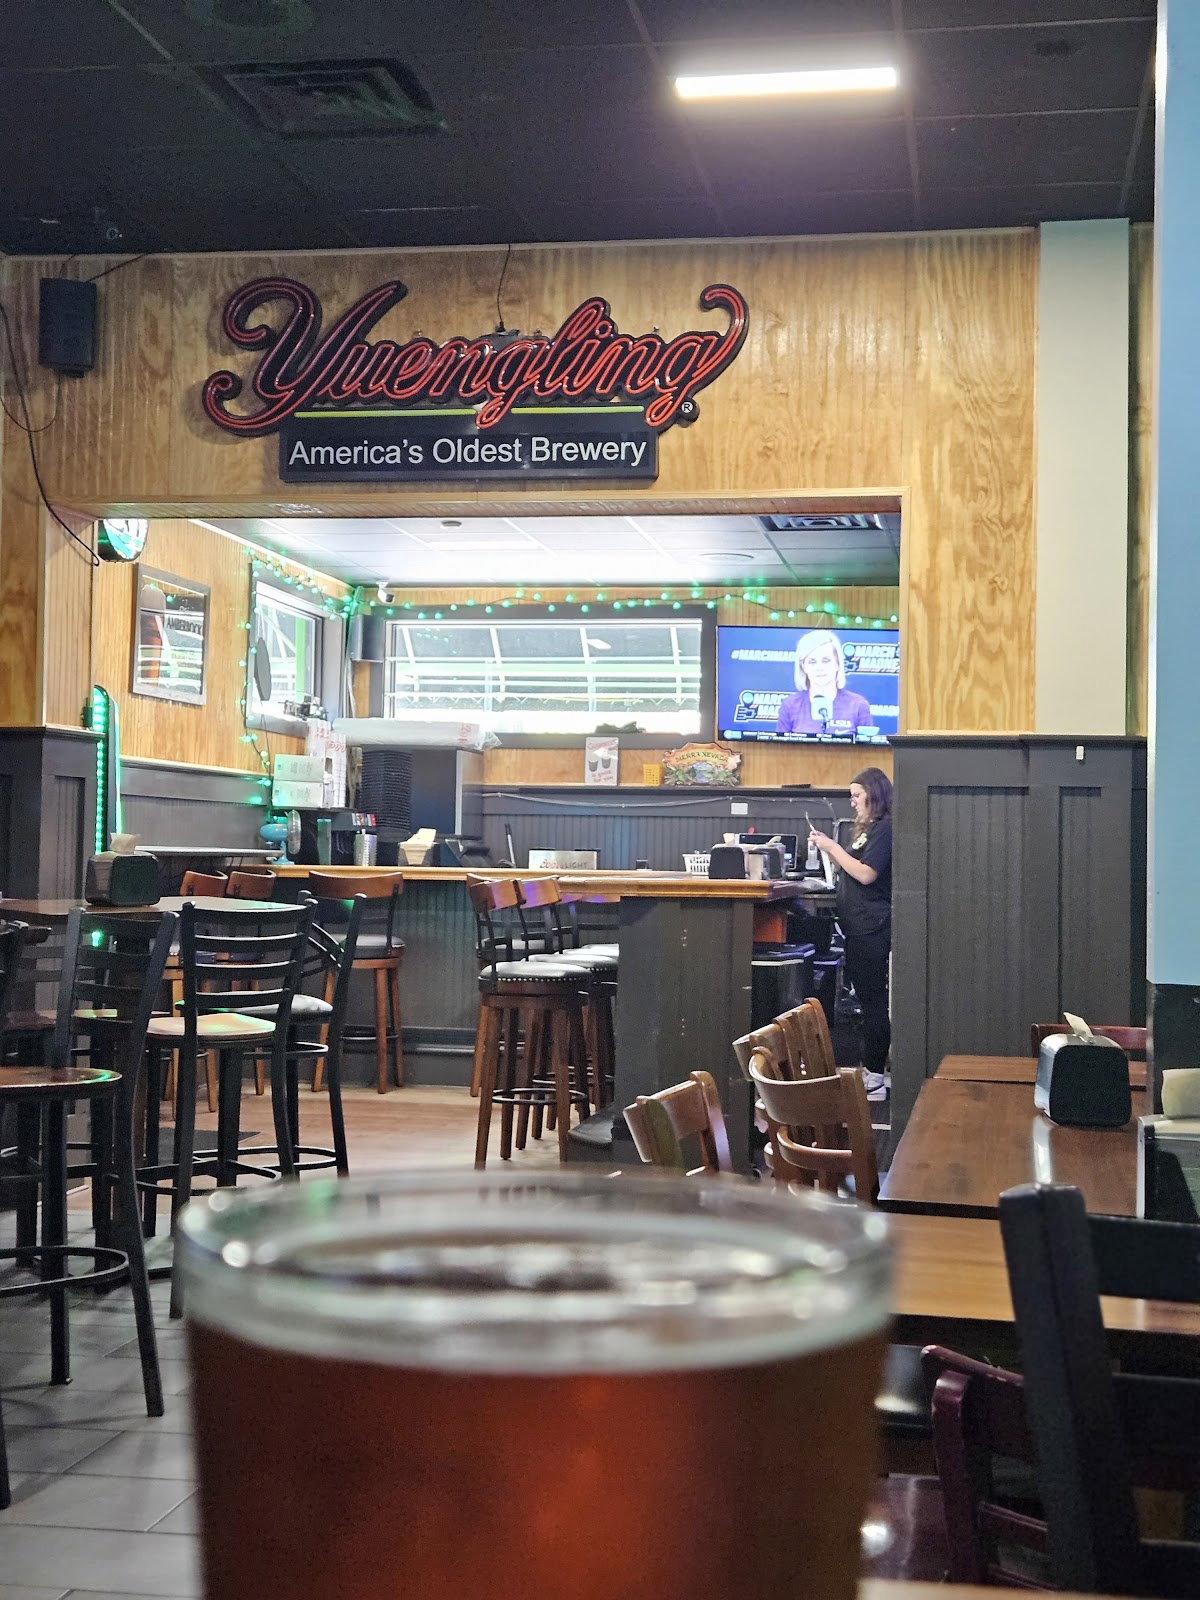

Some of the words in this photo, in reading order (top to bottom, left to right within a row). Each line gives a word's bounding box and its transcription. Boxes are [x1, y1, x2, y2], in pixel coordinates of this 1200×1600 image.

[203, 278, 749, 434] Yuengling
[432, 437, 522, 464] Oldest
[530, 436, 647, 474] Brewery
[854, 646, 896, 657] MARCH
[701, 752, 728, 763] NEVADA
[565, 861, 588, 870] LIGHT
